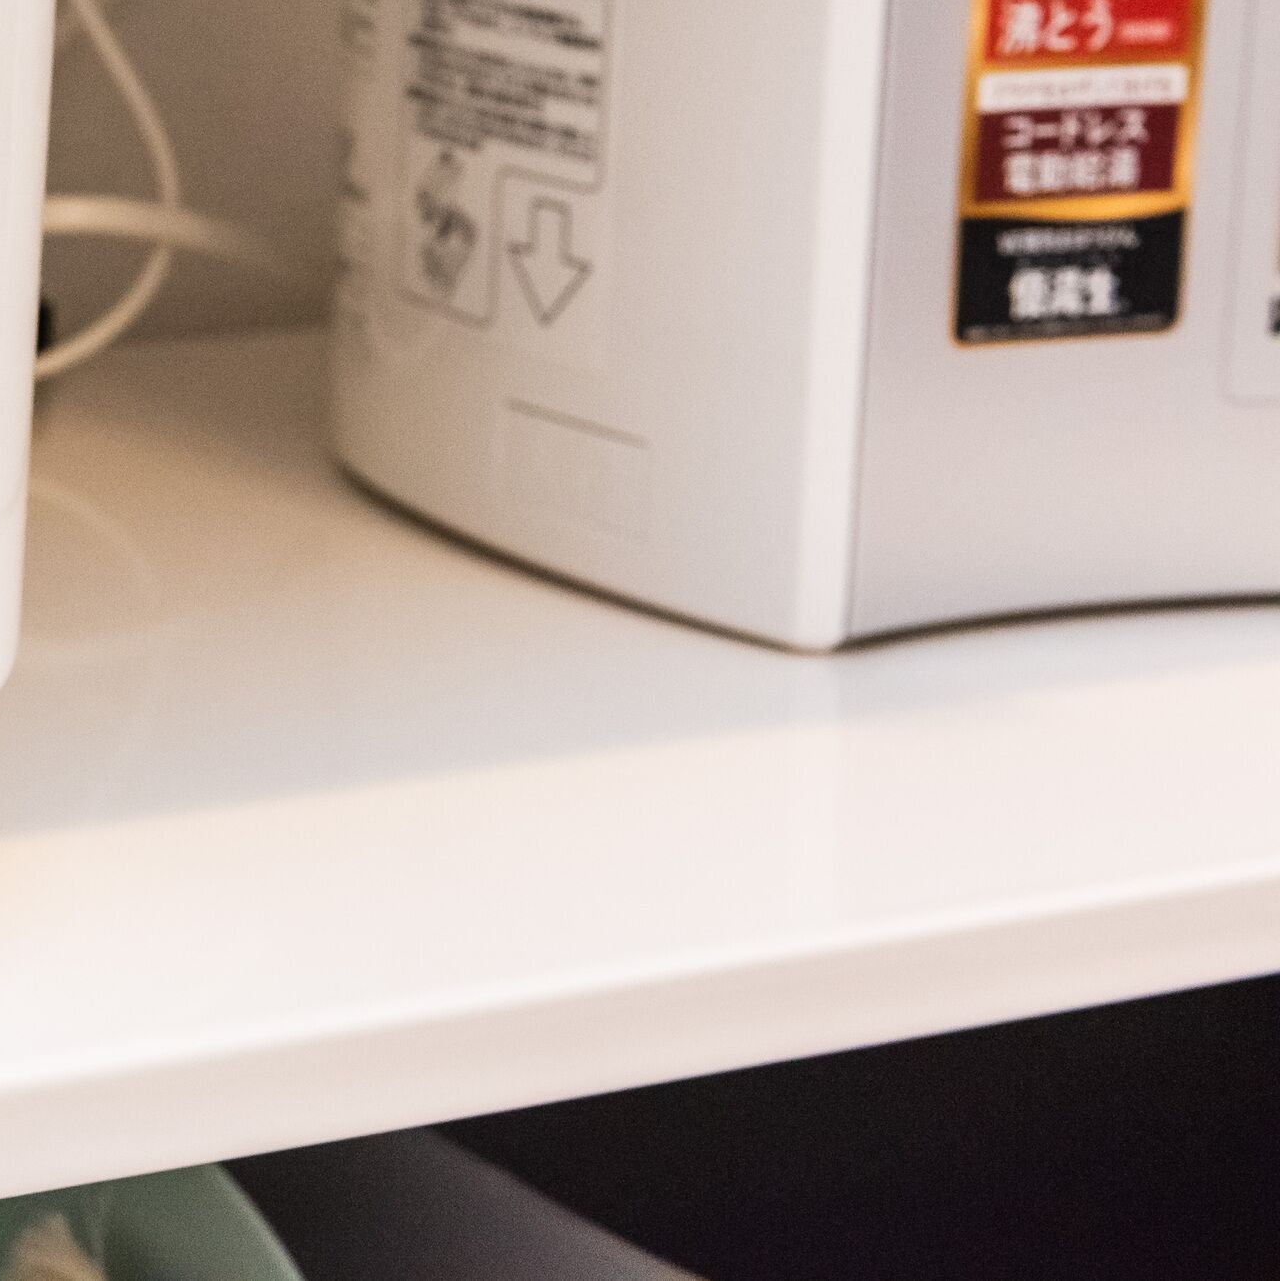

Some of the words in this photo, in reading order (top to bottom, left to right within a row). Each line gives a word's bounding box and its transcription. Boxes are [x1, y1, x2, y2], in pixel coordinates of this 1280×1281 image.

[1002, 108, 1150, 149] コードレス
